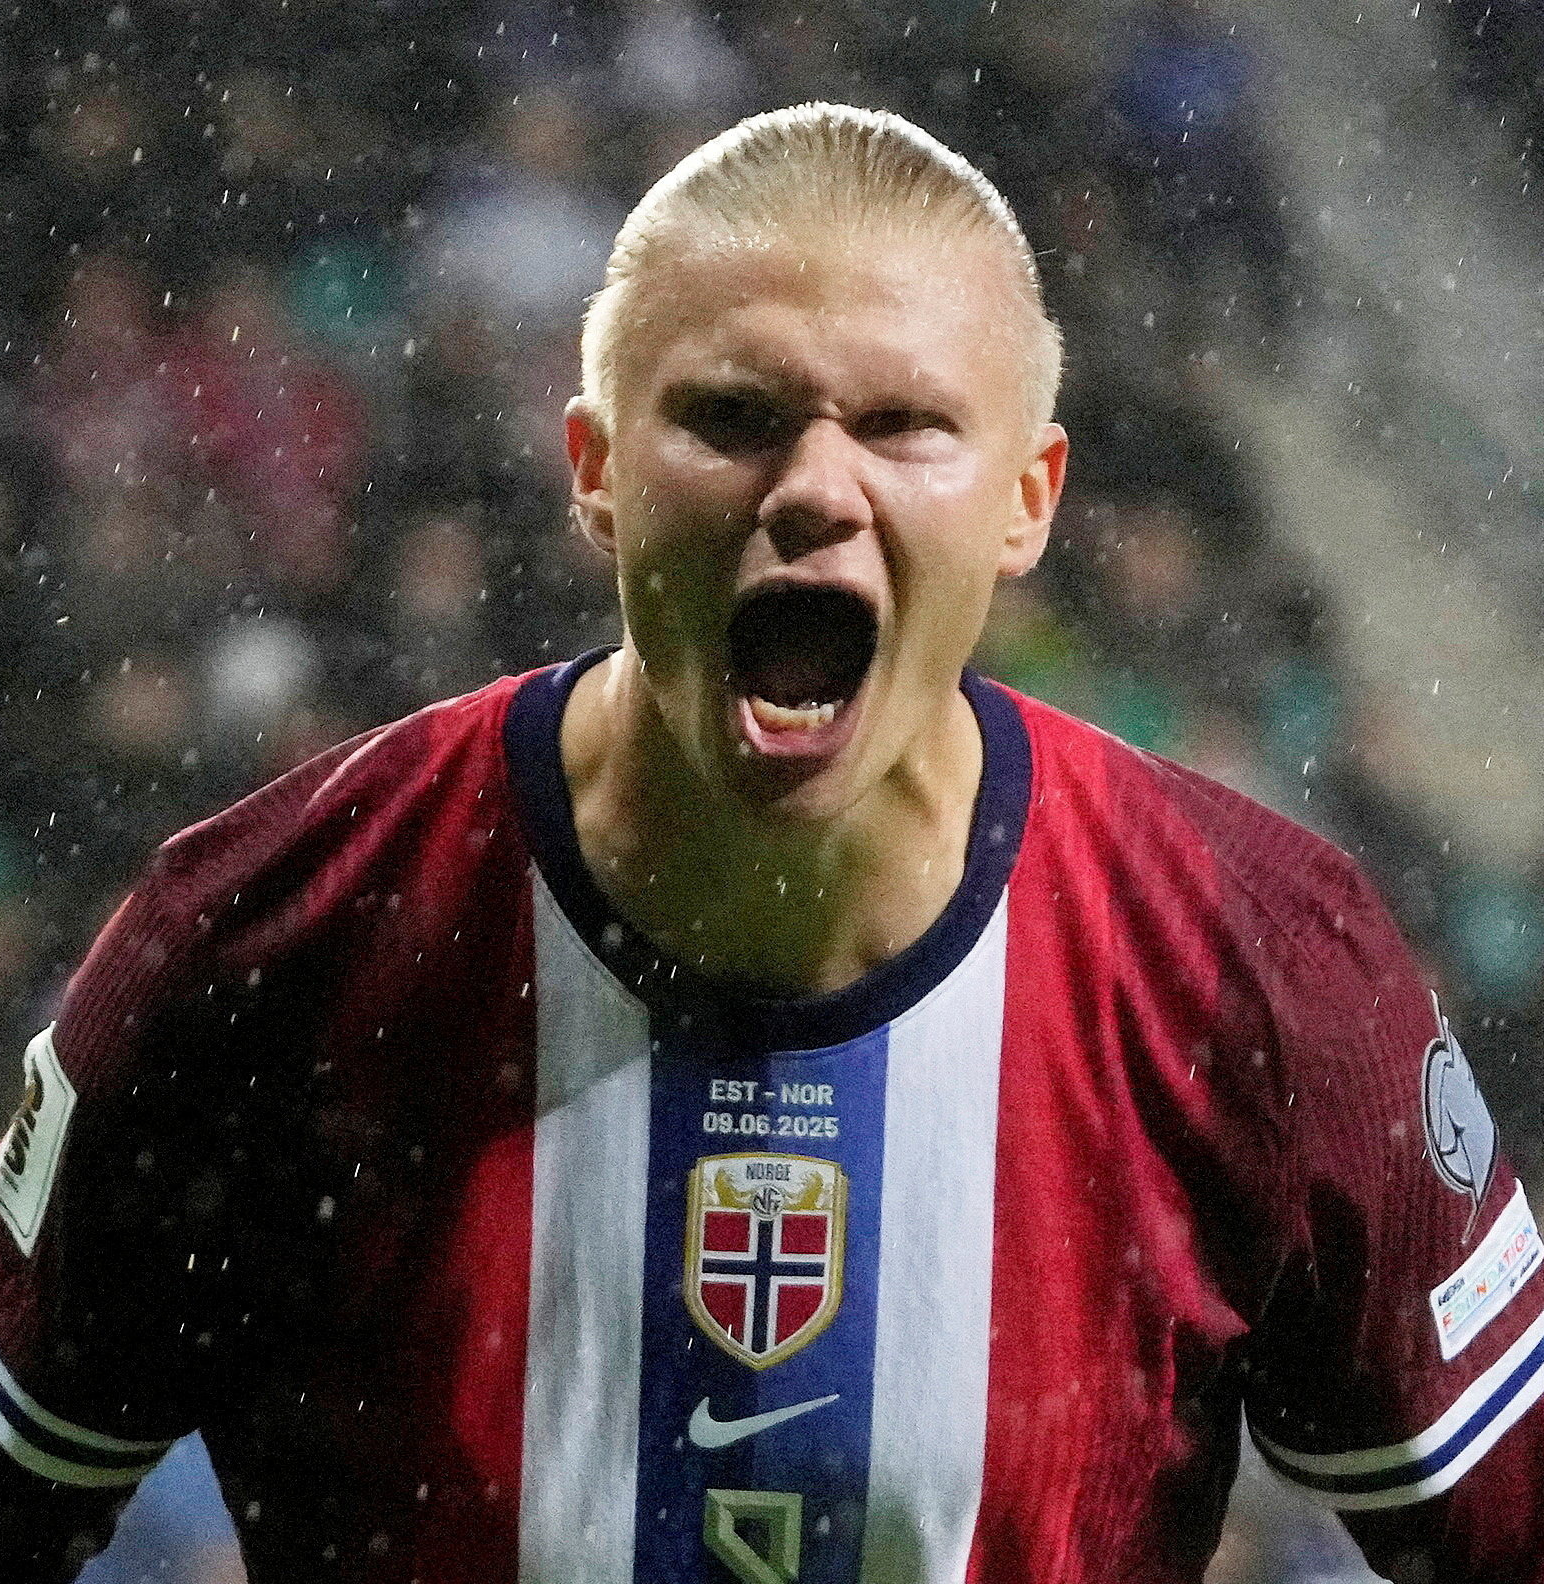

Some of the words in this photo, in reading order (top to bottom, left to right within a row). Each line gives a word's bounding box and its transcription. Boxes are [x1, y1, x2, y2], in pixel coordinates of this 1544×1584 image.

[710, 1079, 758, 1101] EST
[781, 1083, 835, 1105] NOR
[702, 1111, 839, 1137] 09.06.2025
[746, 1163, 792, 1181] NORGE
